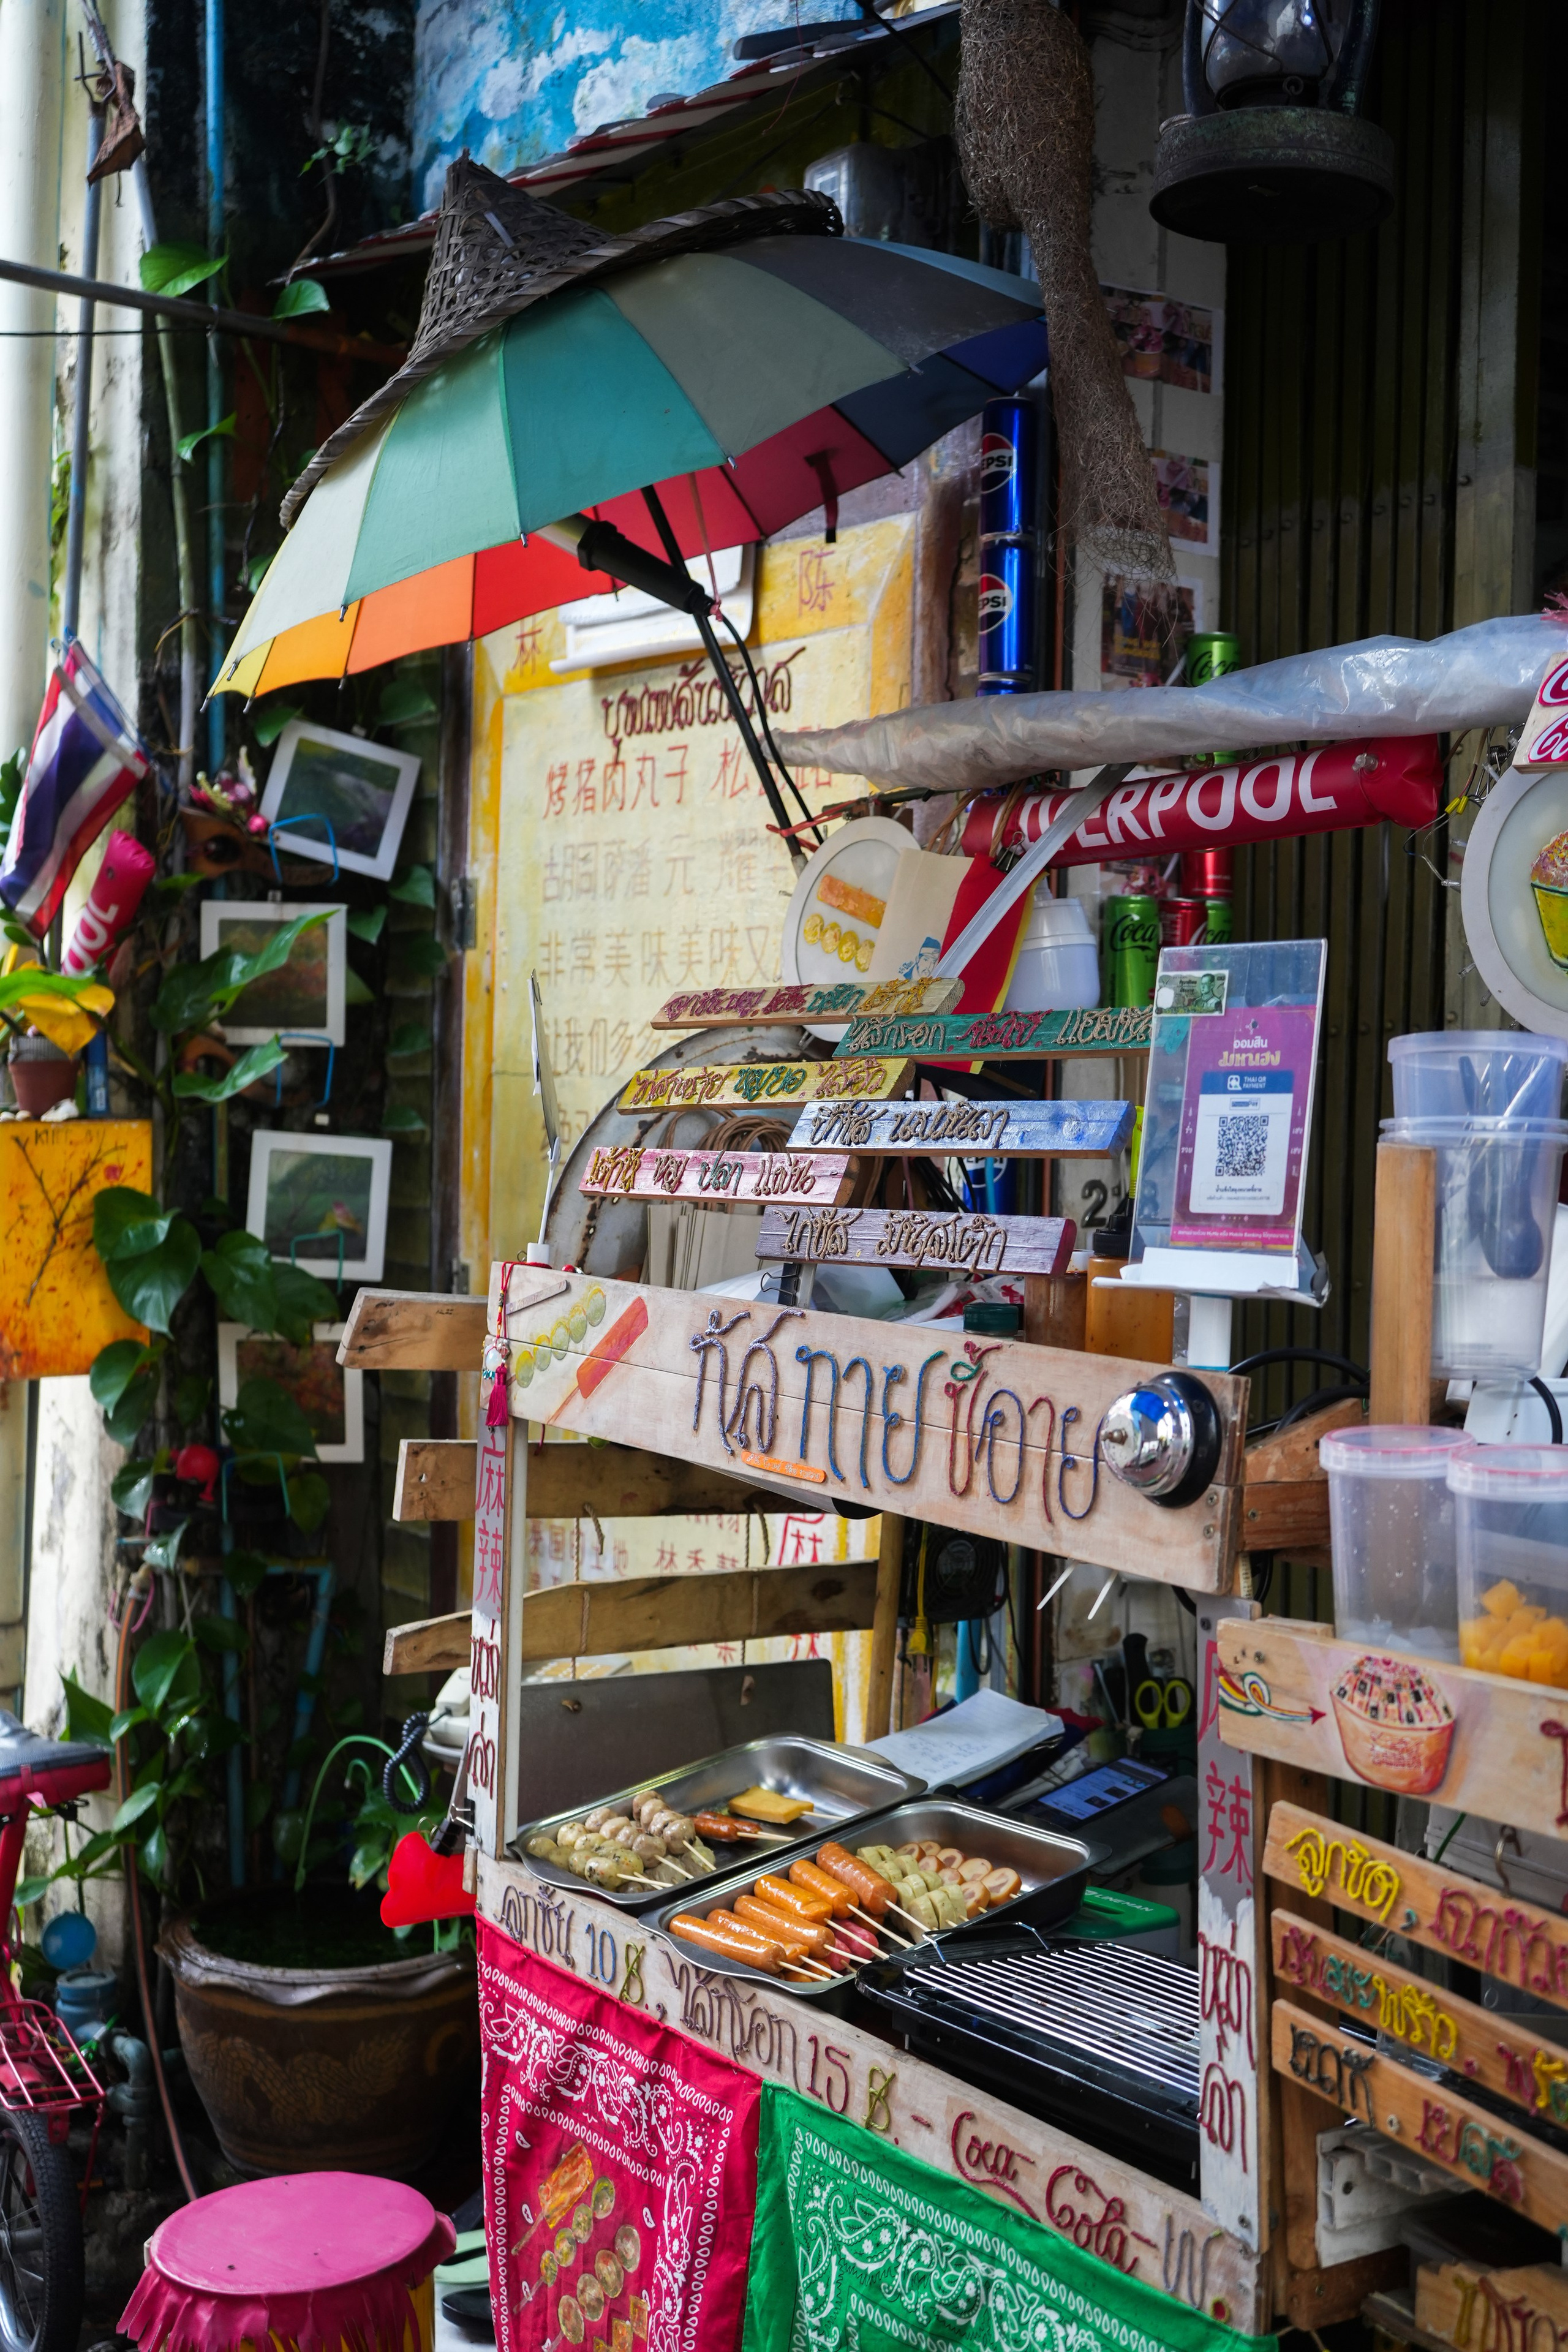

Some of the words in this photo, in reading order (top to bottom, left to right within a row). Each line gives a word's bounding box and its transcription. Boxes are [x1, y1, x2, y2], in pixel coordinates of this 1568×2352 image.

[980, 454, 1012, 471] EPSI
[1110, 913, 1158, 952] Coca
[539, 921, 783, 988] 非常美味美味又
[1233, 1036, 1268, 1049] ออมสิน
[652, 1153, 690, 1194] หมู
[697, 1149, 744, 1196] ปลา
[751, 1151, 816, 1197] แผ่น
[493, 1884, 575, 1967] ลูกชิ้น
[584, 1922, 616, 1985] 10
[807, 2034, 850, 2114] 15
